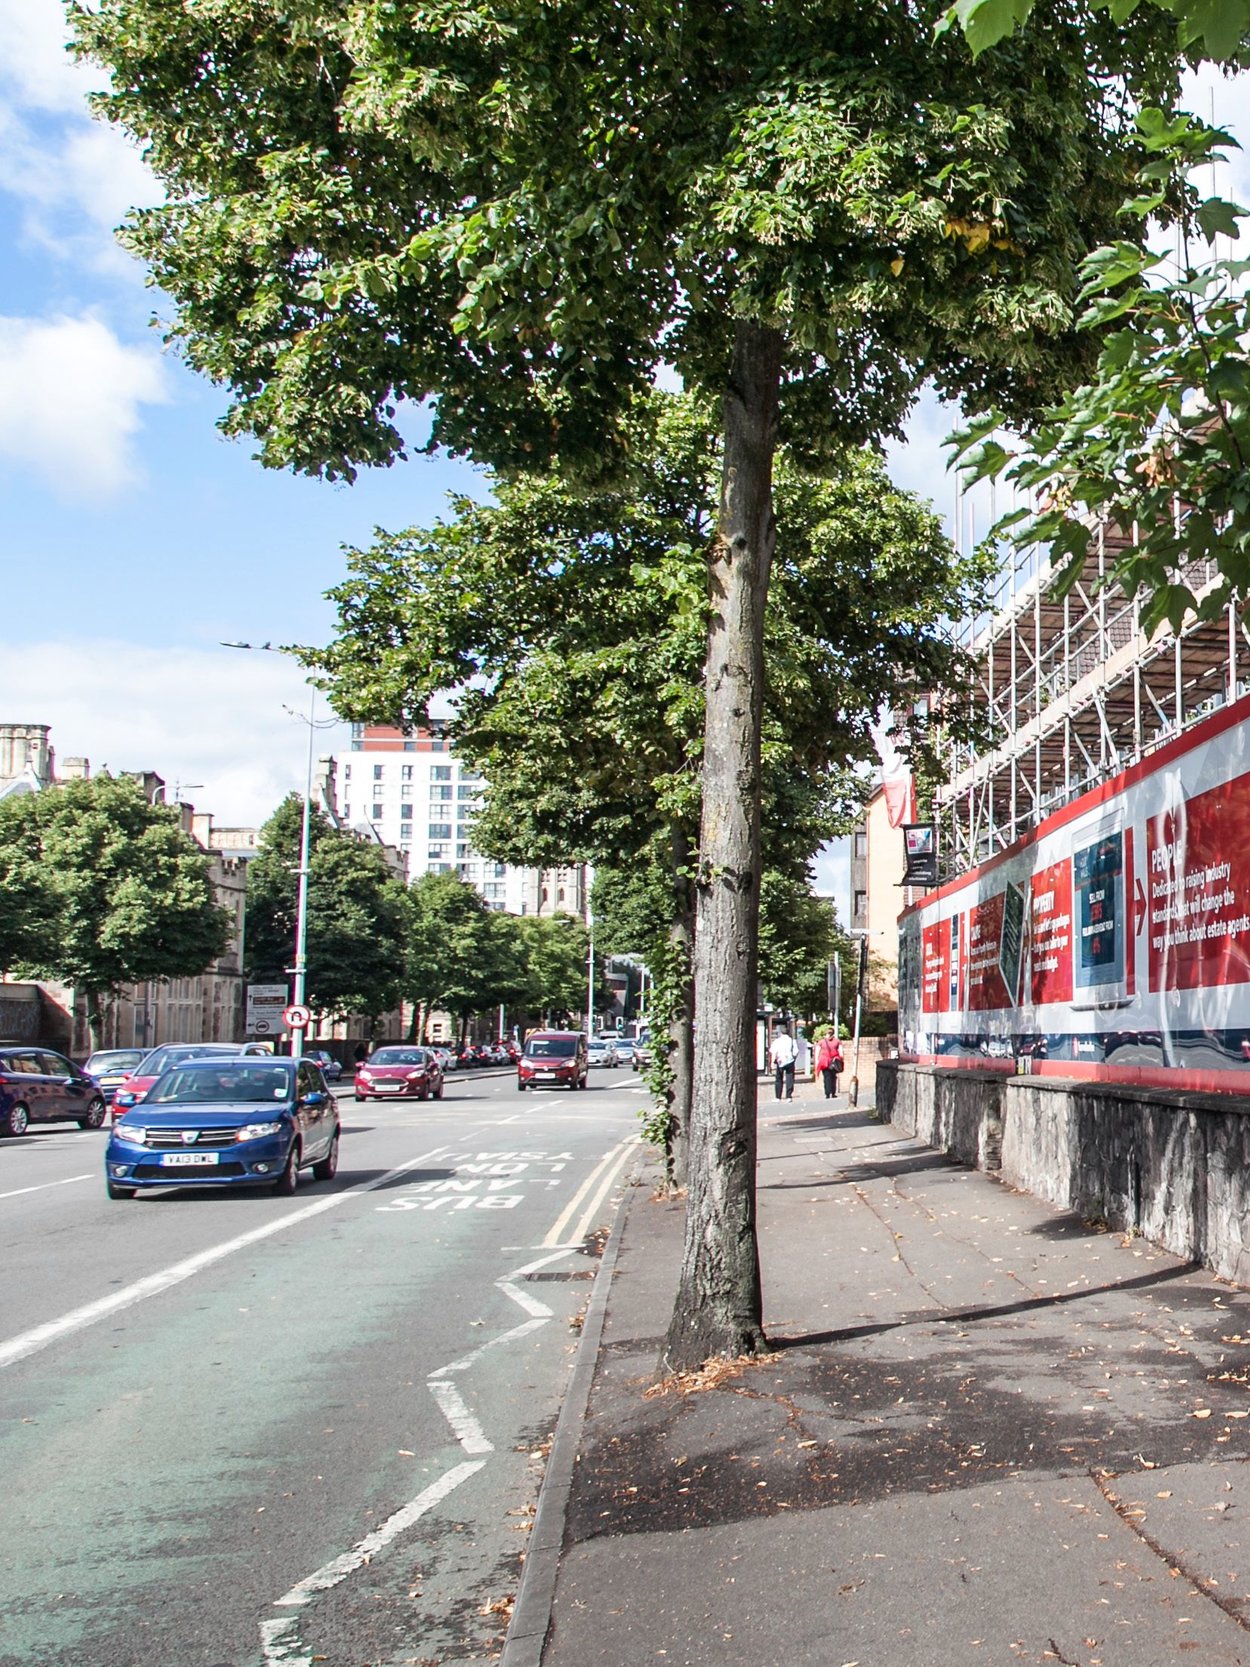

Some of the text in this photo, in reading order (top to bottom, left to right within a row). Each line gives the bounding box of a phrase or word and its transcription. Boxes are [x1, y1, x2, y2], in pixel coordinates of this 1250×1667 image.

[1152, 840, 1182, 873] PEOPLE
[1153, 878, 1177, 898] Dedicated
[1186, 868, 1205, 889] raising
[1206, 861, 1231, 882] industry
[1190, 894, 1200, 914] will
[1201, 892, 1223, 914] change
[1224, 886, 1235, 906] the
[1153, 936, 1163, 952] way
[1164, 934, 1174, 951] you
[1175, 924, 1188, 943] think
[1189, 923, 1206, 941] about
[1208, 920, 1226, 938] estate
[434, 1151, 600, 1161] YSIAU
[395, 1179, 561, 1194] LANE
[374, 1195, 526, 1212] BUS
